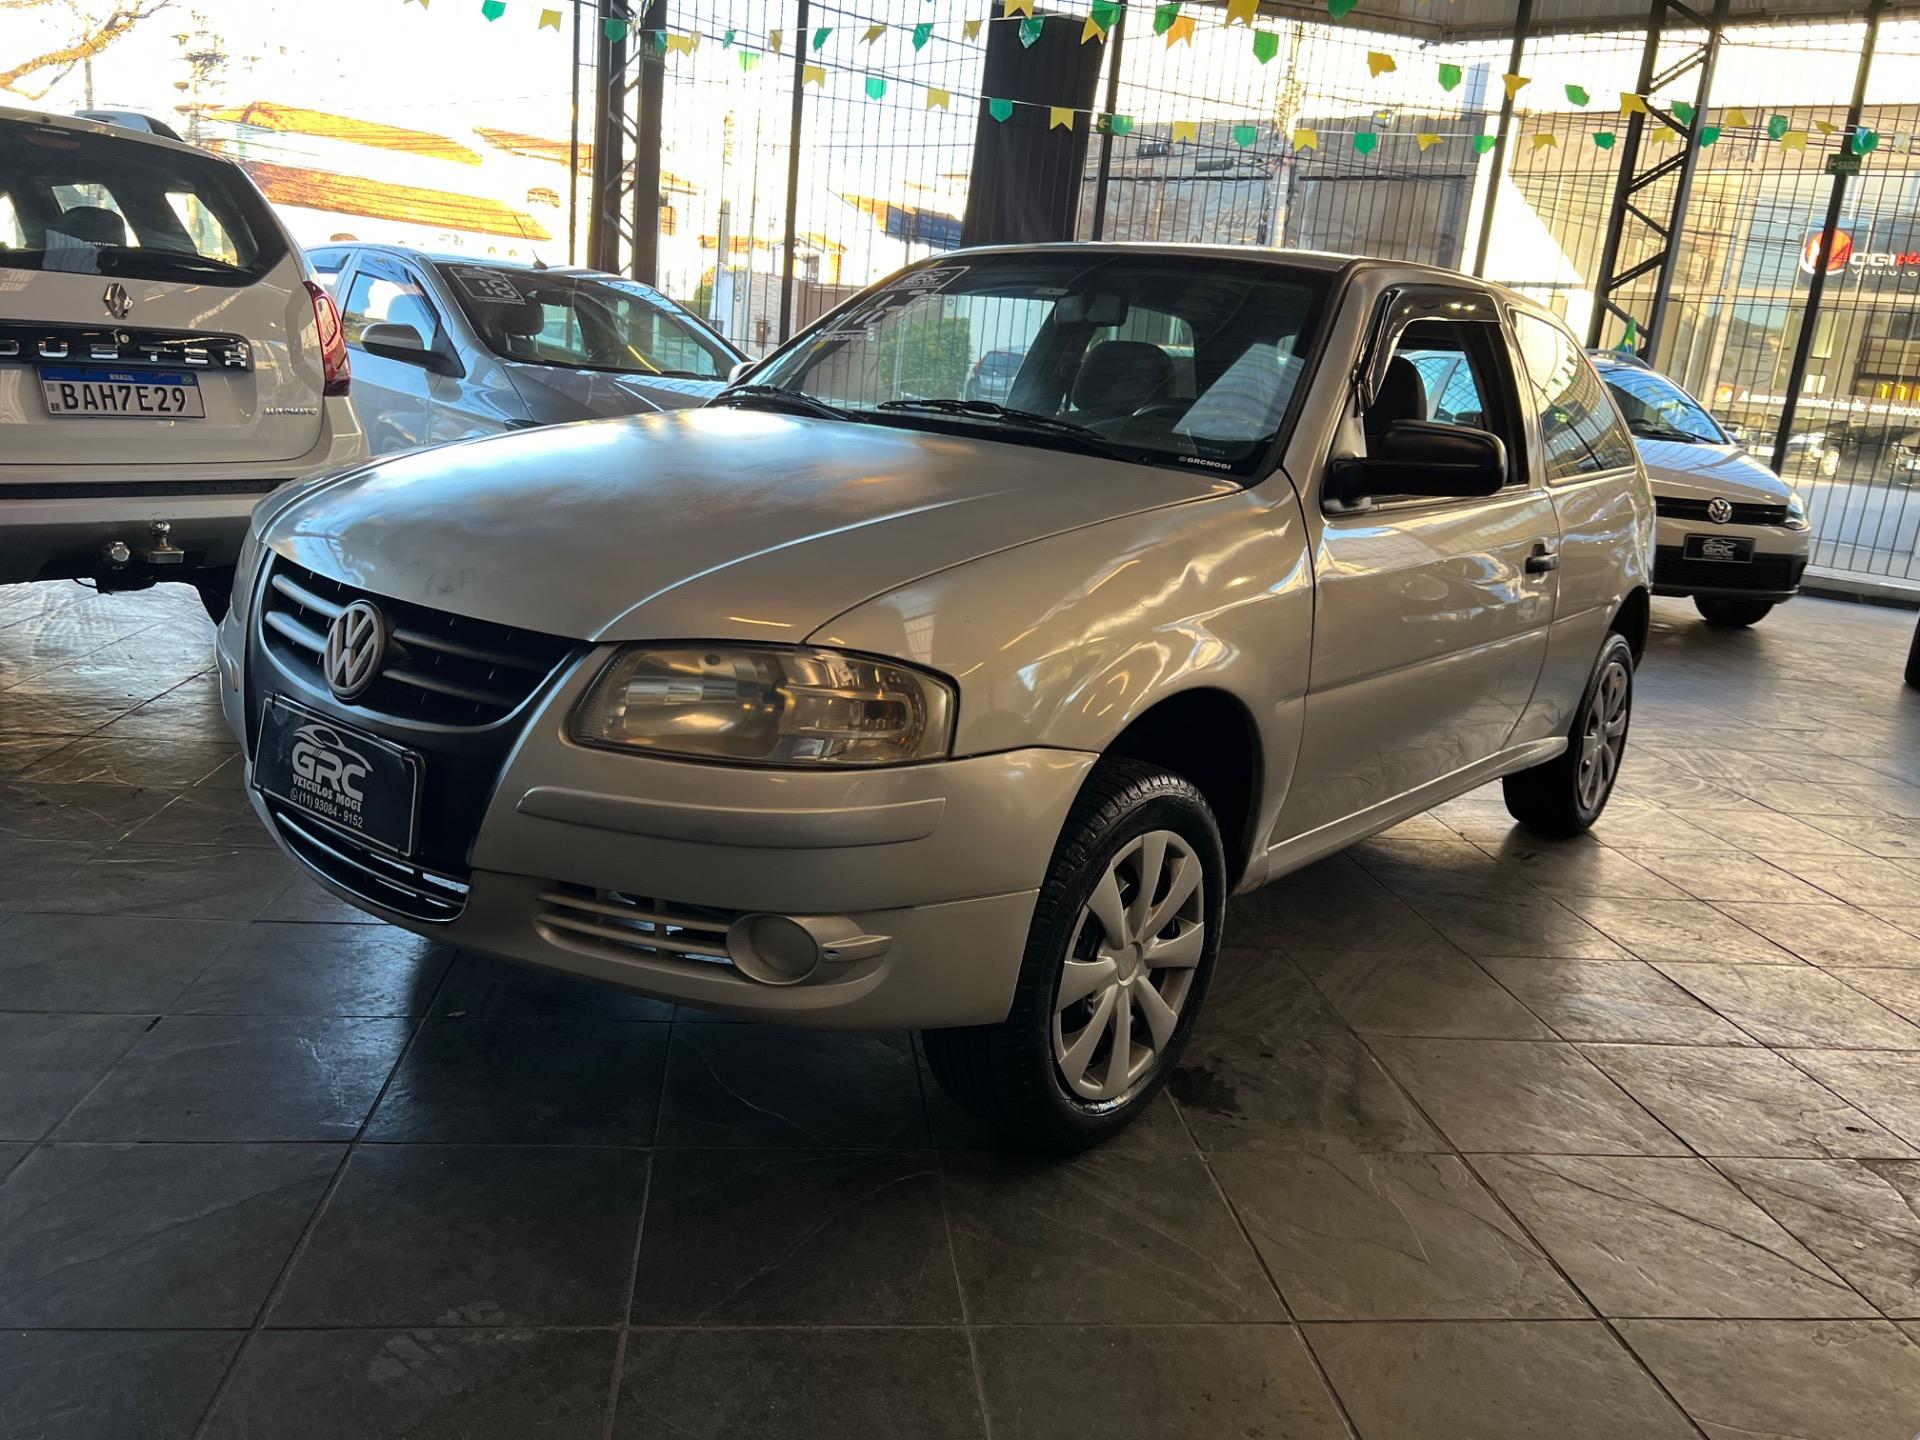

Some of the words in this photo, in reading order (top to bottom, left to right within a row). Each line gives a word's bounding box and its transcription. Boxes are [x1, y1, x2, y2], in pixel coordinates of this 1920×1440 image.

[109, 373, 135, 382] BRASIL
[50, 402, 62, 412] BR
[60, 383, 188, 413] BAH7E29
[263, 407, 318, 416] AUTOMATIC
[291, 741, 366, 803] GRC
[292, 773, 333, 800] VEICULOS
[335, 792, 362, 813] MOGI
[298, 790, 313, 809] (11)
[314, 798, 338, 817] 93084
[343, 810, 363, 829] 9152
